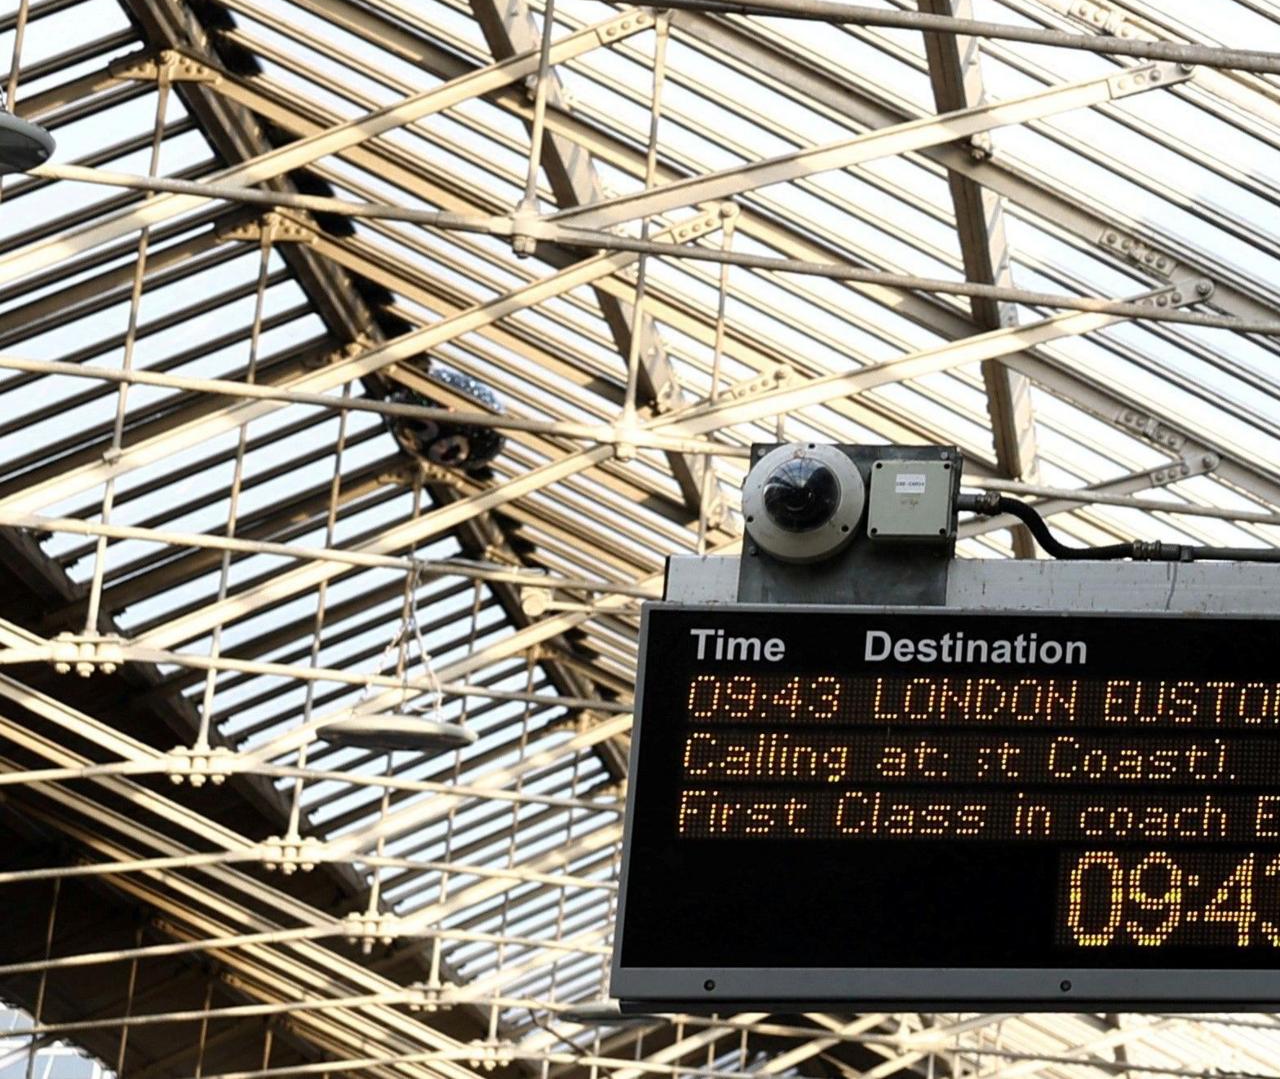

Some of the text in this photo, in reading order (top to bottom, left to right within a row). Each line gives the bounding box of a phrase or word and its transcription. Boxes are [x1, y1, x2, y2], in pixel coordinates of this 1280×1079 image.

[689, 628, 786, 662] Time
[864, 630, 1088, 665] Destination
[687, 674, 842, 720] 09:43
[873, 676, 1078, 722] LONDON
[682, 731, 849, 783] Calling
[875, 740, 950, 778] at:
[678, 789, 808, 834] First
[835, 790, 988, 835] Class
[1014, 791, 1052, 836] in
[1079, 794, 1228, 838] coach
